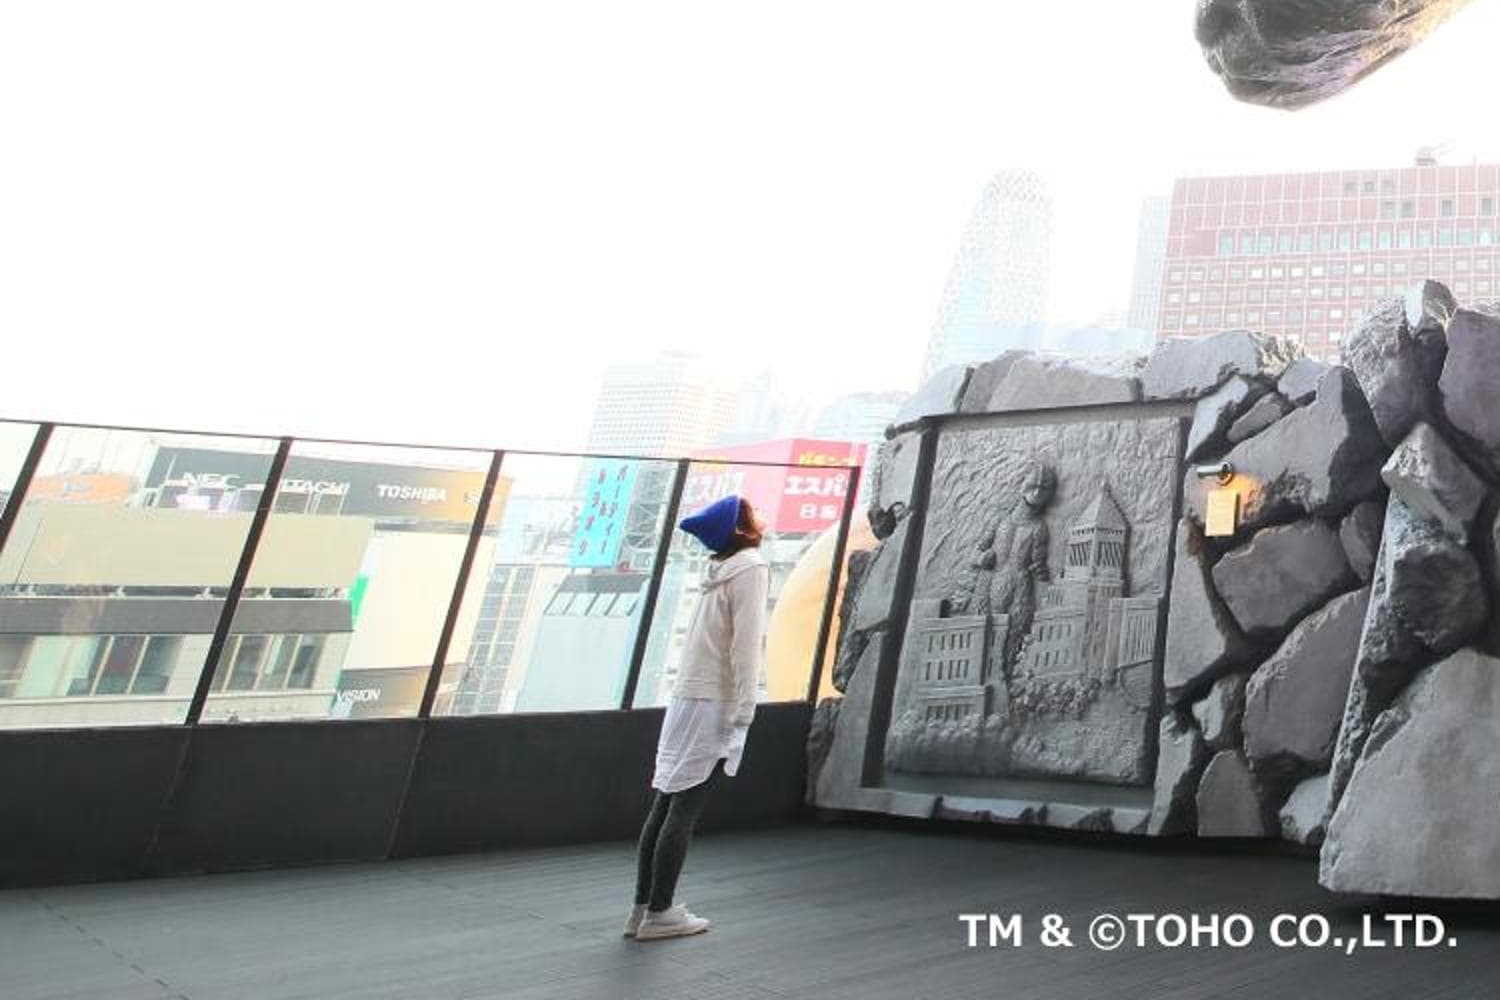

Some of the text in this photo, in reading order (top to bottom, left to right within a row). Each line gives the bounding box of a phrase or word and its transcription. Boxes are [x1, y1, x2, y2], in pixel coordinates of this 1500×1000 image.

[183, 472, 240, 492] NEC
[281, 478, 350, 497] ITACHI
[784, 473, 847, 496] エスパ
[377, 485, 448, 502] TOSHIBA
